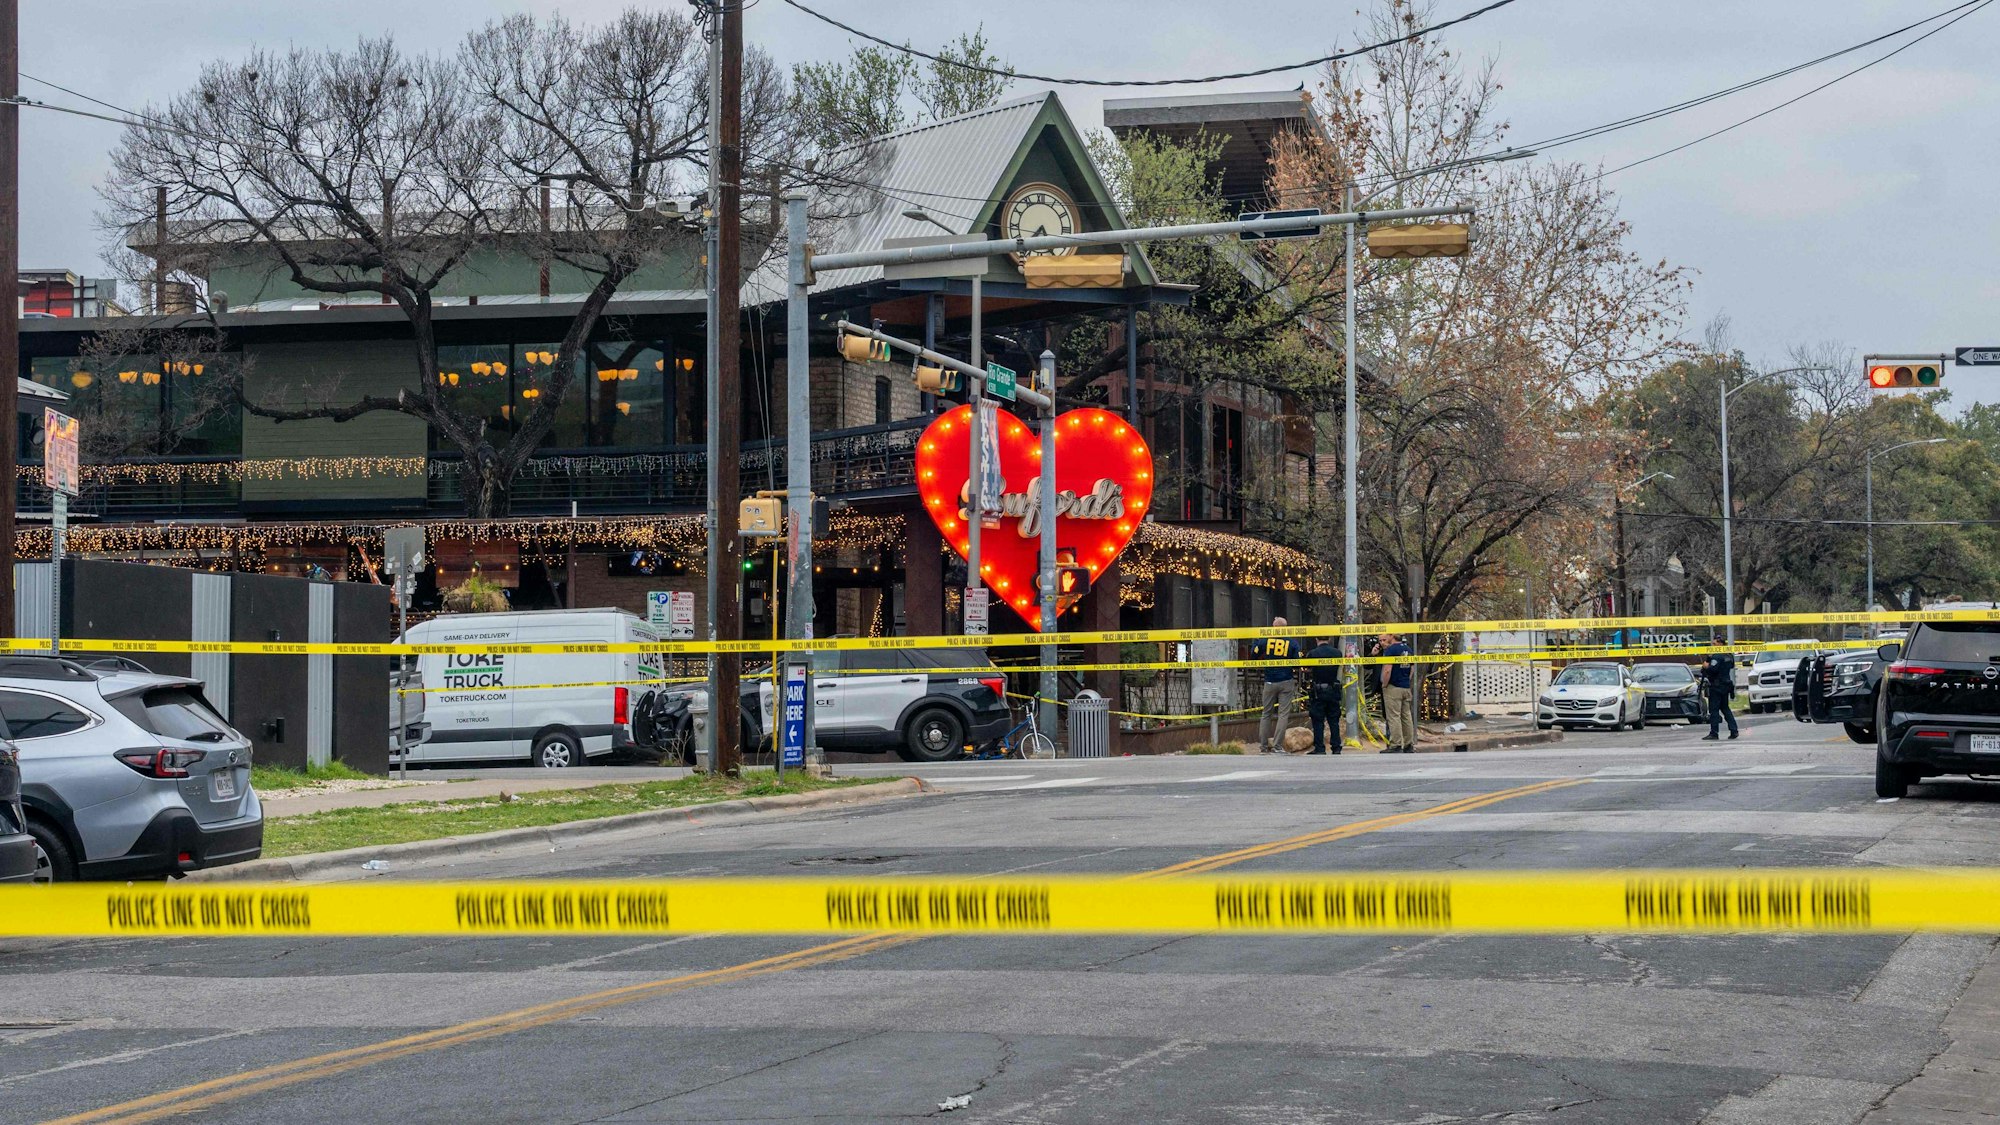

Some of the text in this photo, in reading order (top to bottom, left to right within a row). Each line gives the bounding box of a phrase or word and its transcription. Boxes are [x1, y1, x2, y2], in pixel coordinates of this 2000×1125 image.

[1973, 353, 1989, 361] ONE
[996, 367, 1010, 386] Grande
[1266, 638, 1290, 657] FBI
[1640, 628, 1692, 648] rivers
[444, 673, 503, 688] TRUCK
[1930, 682, 1998, 690] PATHFI
[440, 694, 506, 702] TOKETRUCK.COM
[107, 891, 310, 928] POLICE LINE DO NOT CROSS
[456, 890, 669, 928] POLICE LINE DO NOT CROSS
[827, 882, 1050, 928] POLICE LINE DO NOT CROSS
[1216, 882, 1451, 928] POLICE LINE DO NOT CROSS
[1625, 878, 1871, 928] POLICE LINE DO NOT CROSS
